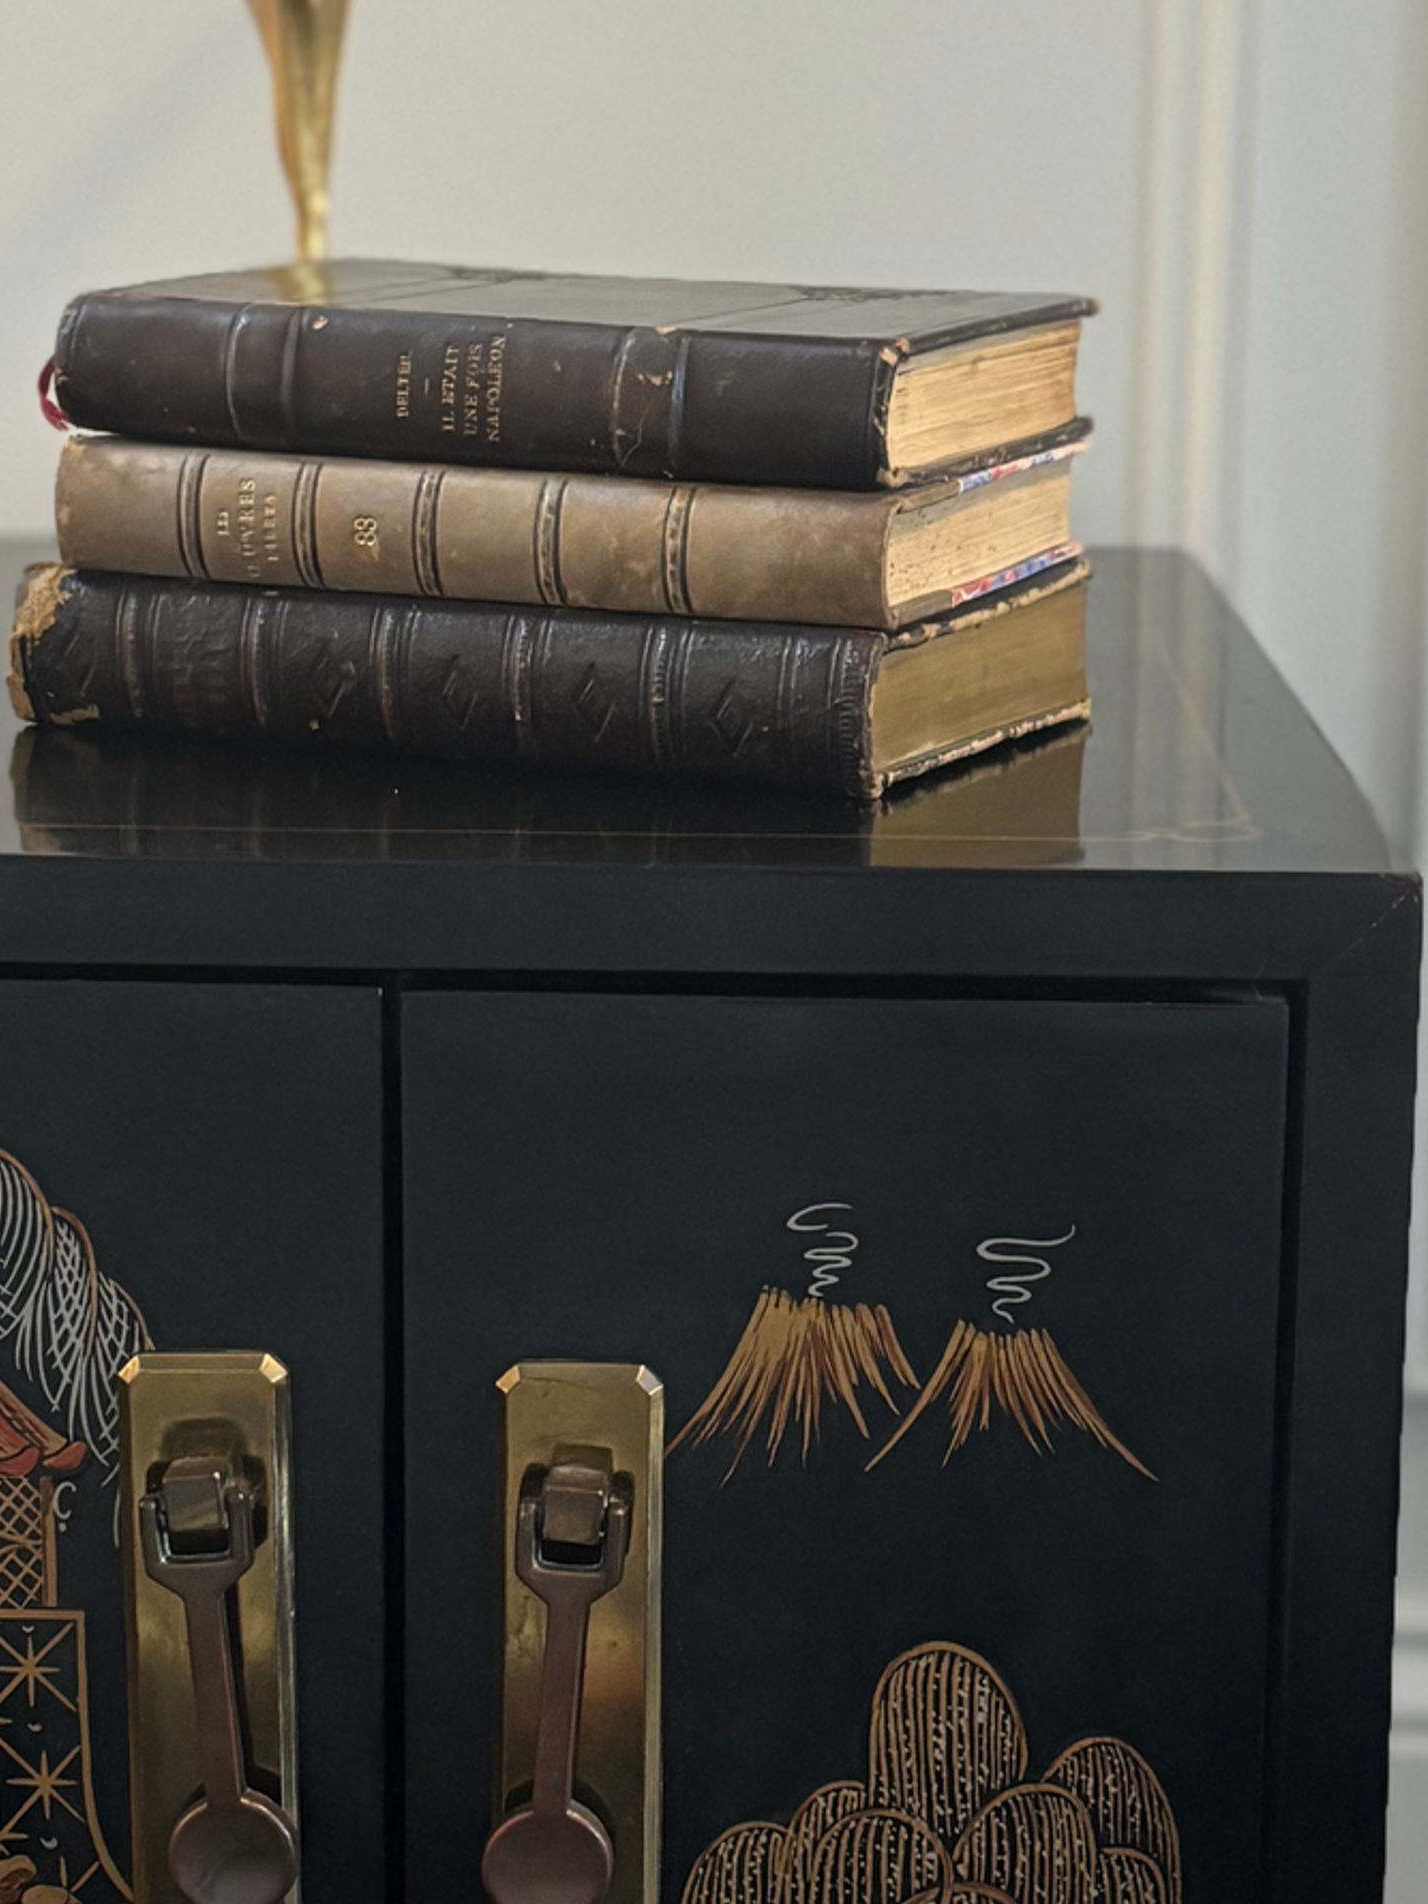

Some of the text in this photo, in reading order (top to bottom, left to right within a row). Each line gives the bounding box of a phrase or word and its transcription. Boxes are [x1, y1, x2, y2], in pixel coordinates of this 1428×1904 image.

[441, 345, 459, 431] IL ETAIT
[463, 343, 483, 435] UNE FOIS
[486, 336, 506, 441] NAPOLEON
